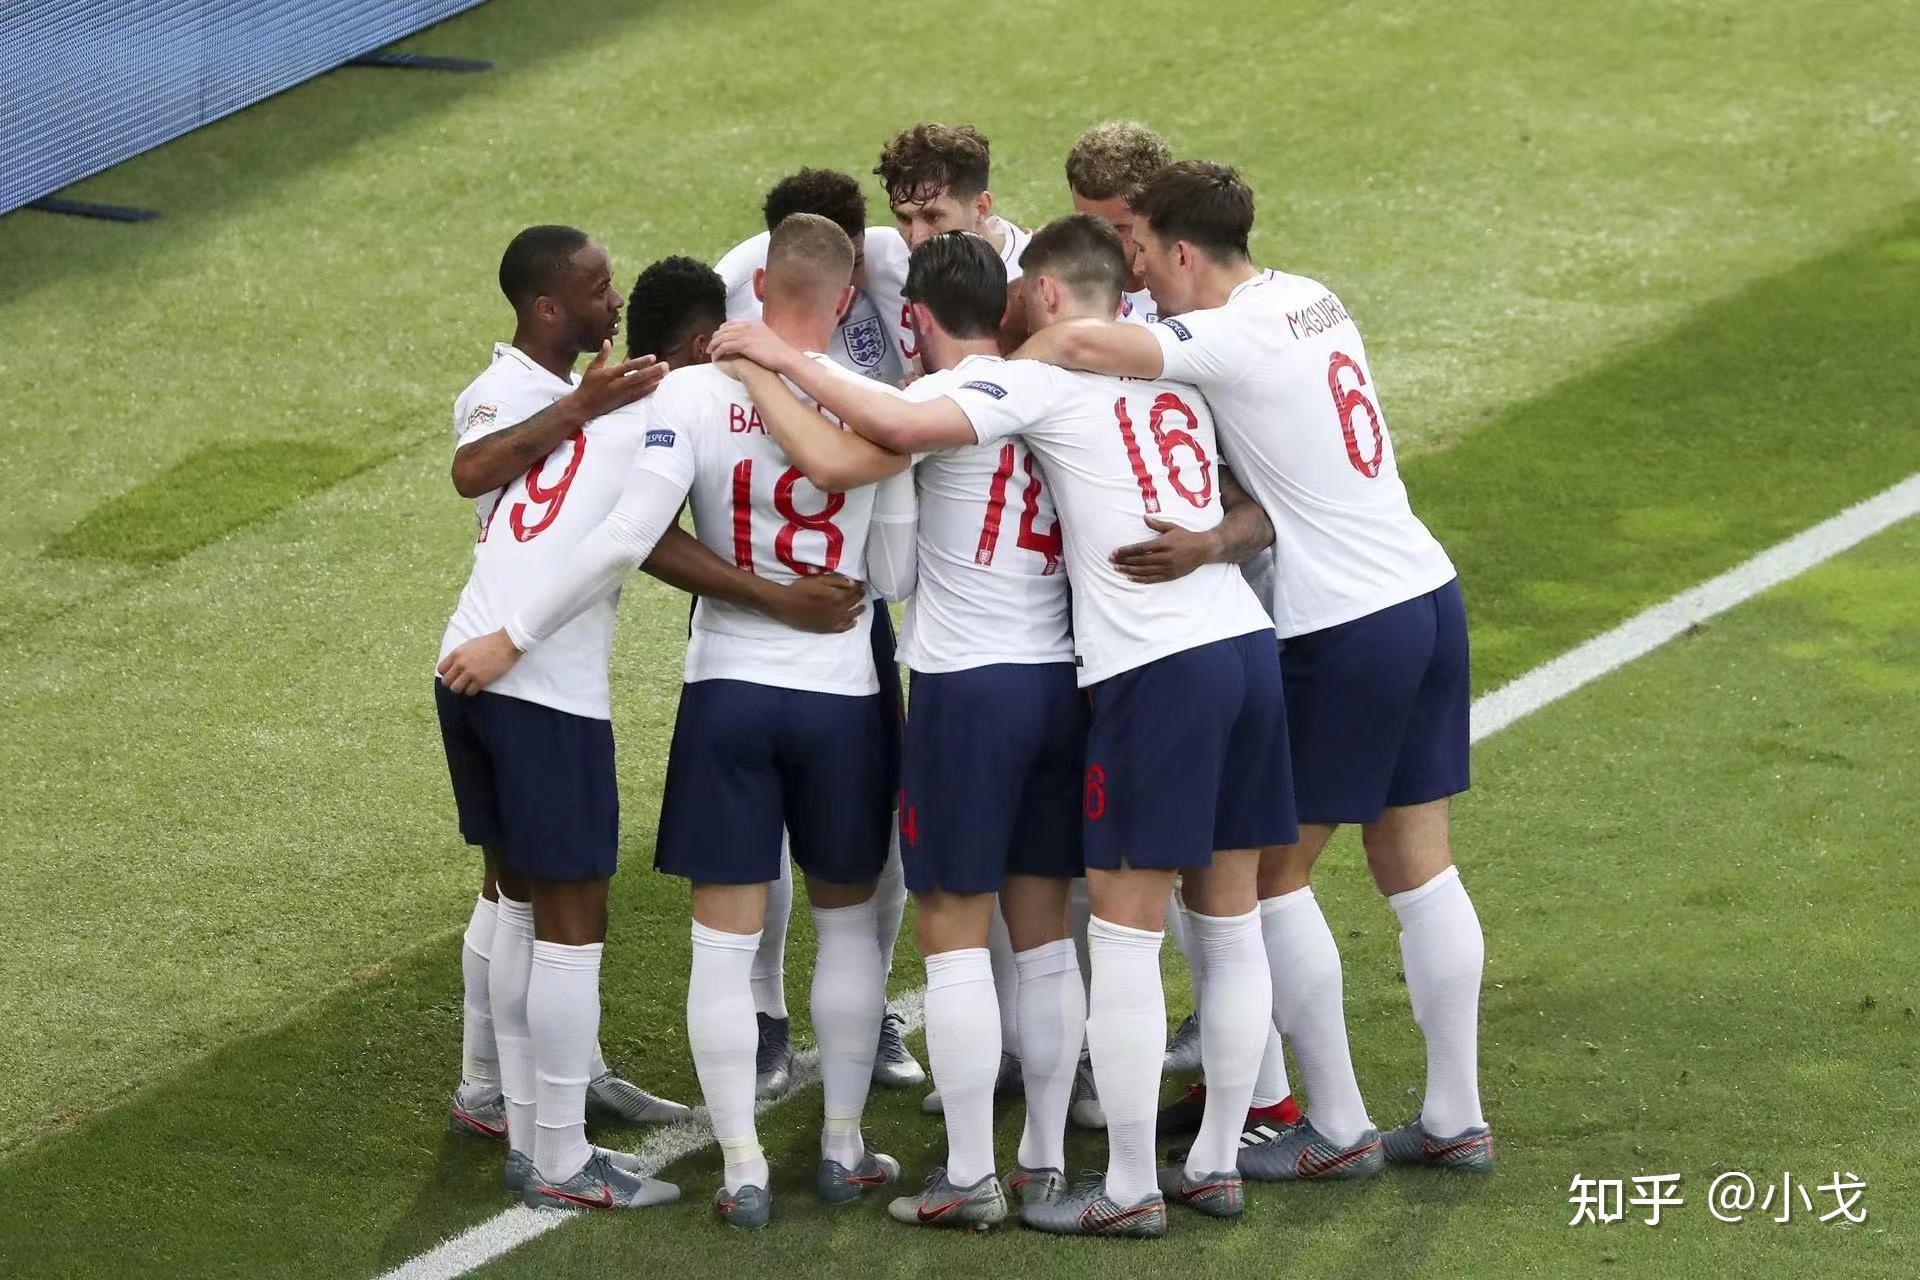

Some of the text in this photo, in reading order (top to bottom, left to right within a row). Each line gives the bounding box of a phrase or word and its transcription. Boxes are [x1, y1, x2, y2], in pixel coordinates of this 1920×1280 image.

[1114, 392, 1212, 514] 16
[1328, 351, 1383, 479] 6
[733, 459, 846, 577] 18
[1085, 764, 1105, 821] 6
